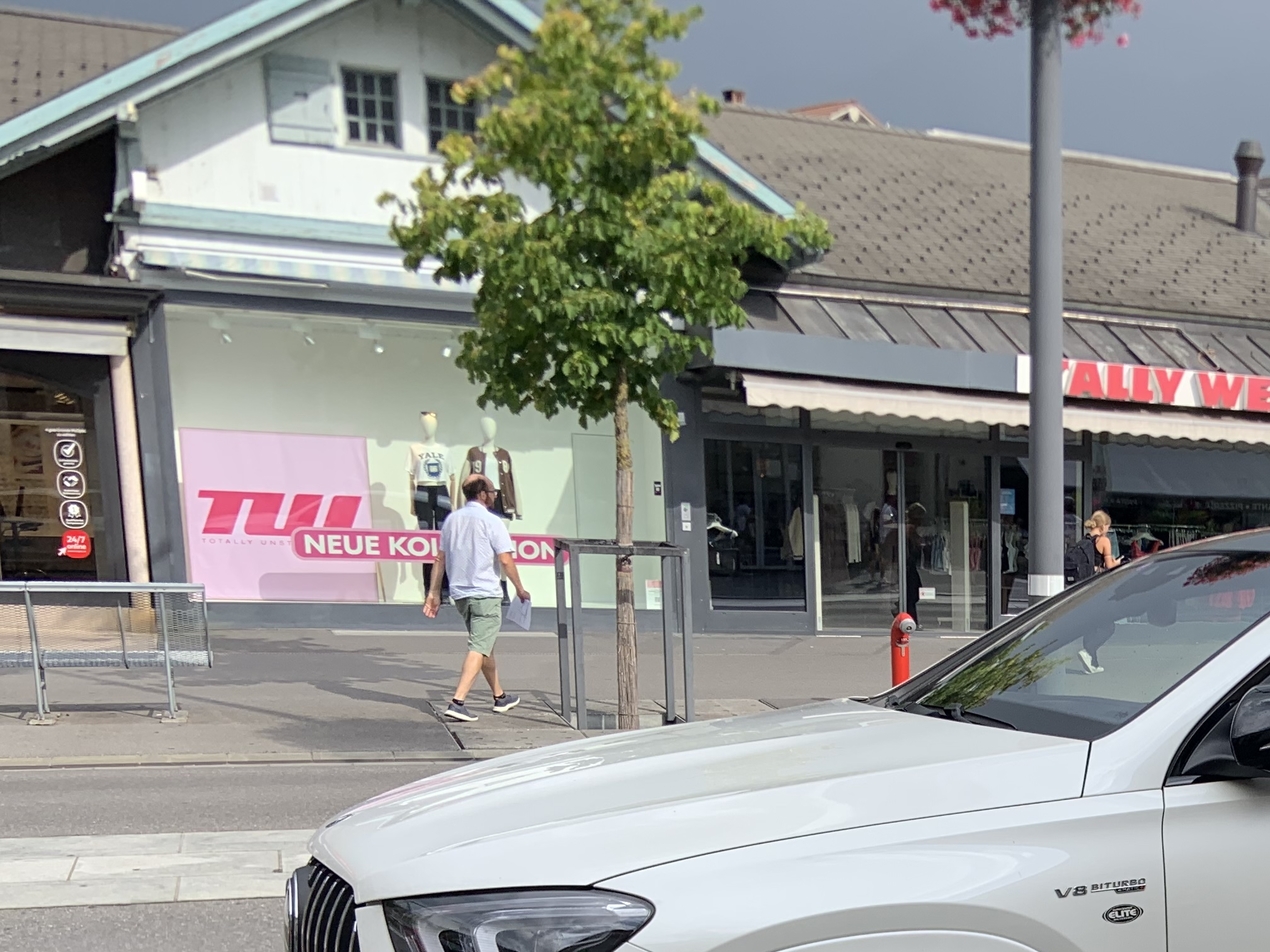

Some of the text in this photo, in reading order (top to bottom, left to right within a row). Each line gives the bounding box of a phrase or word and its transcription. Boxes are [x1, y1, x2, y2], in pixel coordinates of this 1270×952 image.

[1062, 358, 1185, 404] ALLY
[418, 452, 444, 460] YALE
[66, 535, 85, 543] 24/7
[303, 533, 380, 555] NEUE
[1054, 885, 1087, 898] V8
[1091, 878, 1146, 890] BITURBO
